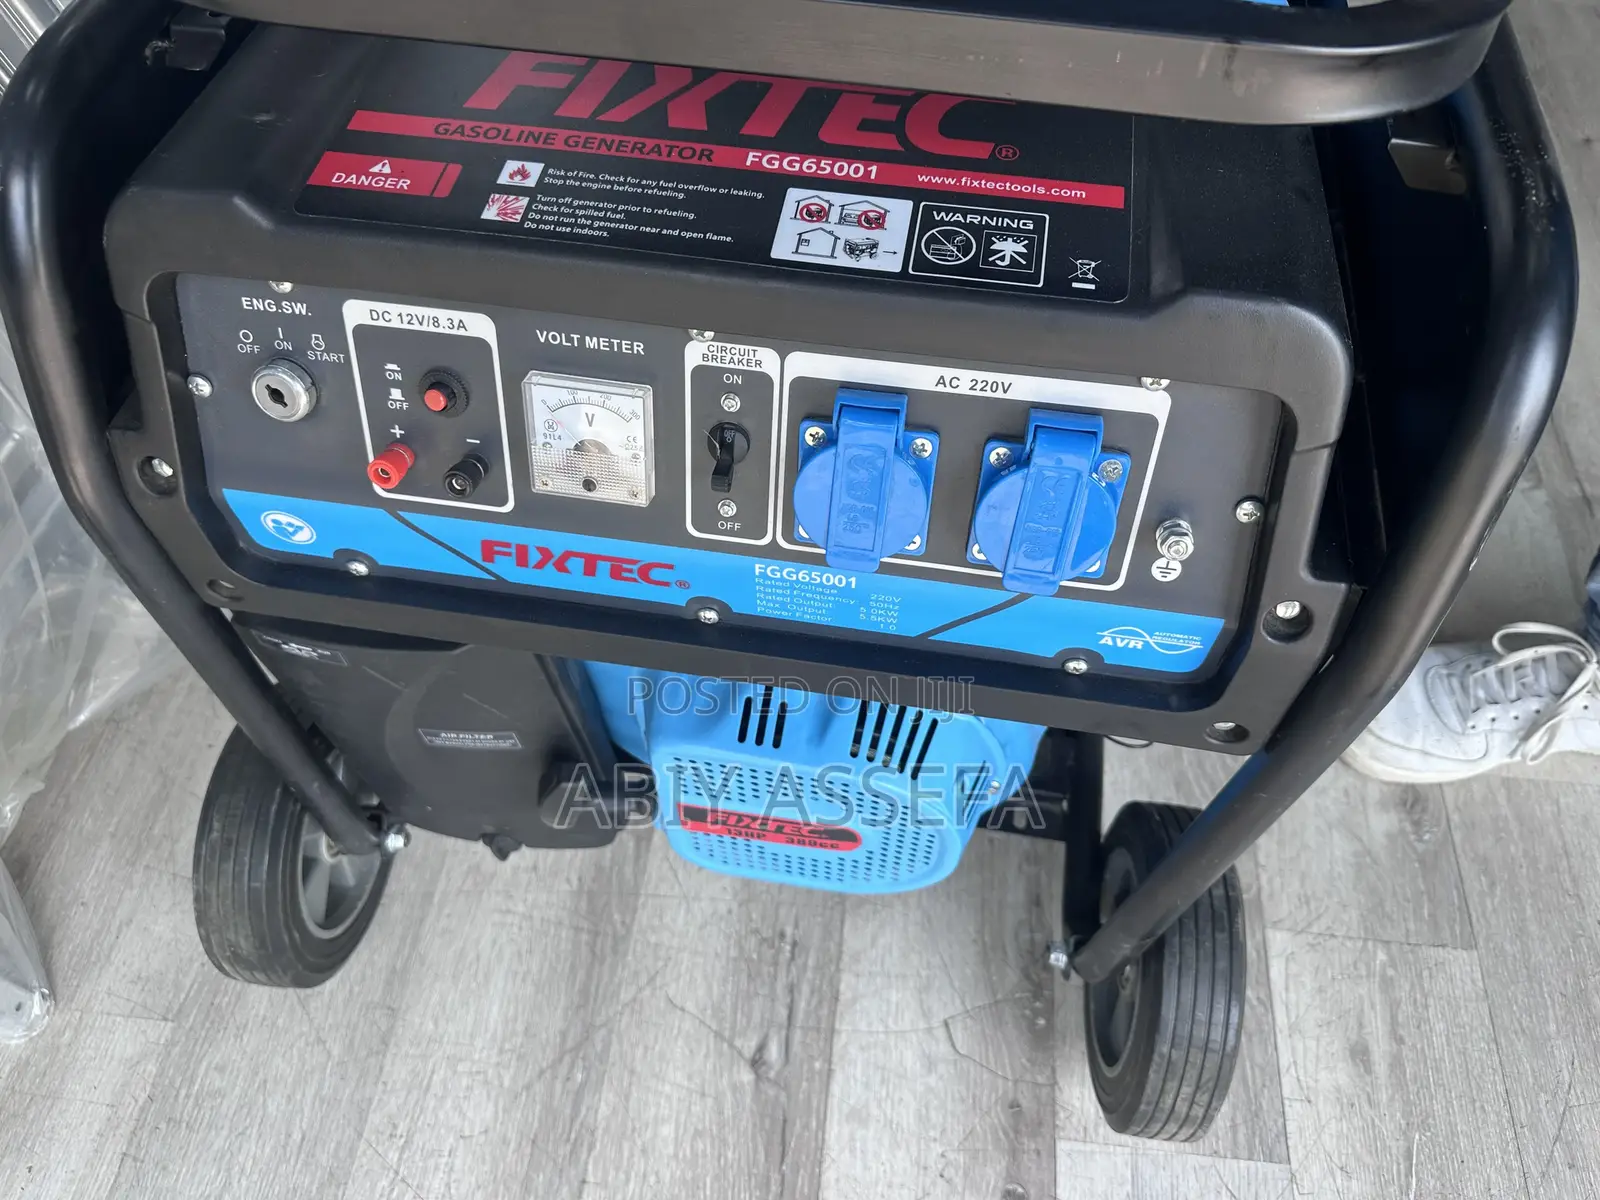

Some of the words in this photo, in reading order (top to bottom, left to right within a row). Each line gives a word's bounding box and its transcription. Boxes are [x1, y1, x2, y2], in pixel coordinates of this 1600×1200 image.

[463, 51, 1016, 160] FIXTEC
[433, 122, 558, 147] GASOLINE
[563, 134, 714, 163] GENERATOR
[746, 151, 878, 180] FGG65001
[917, 172, 1087, 199] www.fixtectools.com
[331, 171, 411, 191] DANGER
[544, 176, 565, 187] Stop
[566, 179, 582, 188] the
[582, 181, 612, 193] engine
[613, 183, 643, 194] before
[644, 187, 687, 200] refueling.
[547, 167, 566, 177] Risk
[567, 170, 578, 178] of
[579, 171, 597, 180] Fire.
[599, 173, 625, 183] Check
[626, 176, 640, 185] for
[641, 179, 658, 188] any
[659, 179, 677, 189] fuel
[678, 183, 718, 194] overflow
[730, 187, 765, 200] leaking.
[532, 203, 558, 213] Check
[560, 206, 574, 214] for
[575, 208, 605, 218] spilled
[606, 211, 627, 220] fuel.
[536, 194, 557, 203] Turn
[558, 197, 573, 205] off
[572, 198, 617, 210] generator
[617, 203, 641, 213] prior
[642, 206, 653, 214] to
[654, 208, 697, 220] refueling.
[528, 212, 541, 220] Do
[542, 214, 559, 222] not
[577, 217, 592, 226] the
[593, 219, 639, 231] generator
[639, 225, 661, 234] near
[661, 228, 680, 236] and
[680, 230, 704, 240] open
[705, 232, 735, 243] flame.
[933, 210, 1034, 230] WARNING
[524, 221, 537, 230] Do
[538, 224, 555, 232] not
[573, 227, 611, 238] indoors.
[241, 297, 313, 316] ENG.SW.
[369, 308, 393, 324] DC
[397, 312, 469, 333] 12V/8.3A
[237, 342, 261, 355] OFF
[274, 339, 294, 352] ON
[536, 328, 582, 348] VOLT
[585, 336, 646, 356] METER
[706, 343, 759, 359] CIRCUIT
[307, 350, 346, 364] START
[701, 353, 764, 370] BREAKER
[386, 371, 403, 382] ON
[723, 373, 743, 385] ON
[934, 373, 962, 390] AC
[968, 376, 1014, 396] 220V
[388, 400, 410, 412] OFF
[584, 412, 596, 428] V
[717, 520, 742, 533] OFF
[480, 539, 676, 588] FIXTEC
[754, 563, 858, 590] FGG65001
[755, 577, 790, 588] Rated
[793, 583, 839, 595] Voltage
[869, 593, 902, 604] 220V
[755, 592, 790, 603] Rated
[755, 585, 790, 595] Rated
[793, 590, 856, 606] Frequency
[869, 601, 900, 611] 50Hz
[756, 606, 792, 618] Power
[1098, 635, 1144, 651] AVR
[1153, 631, 1201, 642] AUTOMATIC
